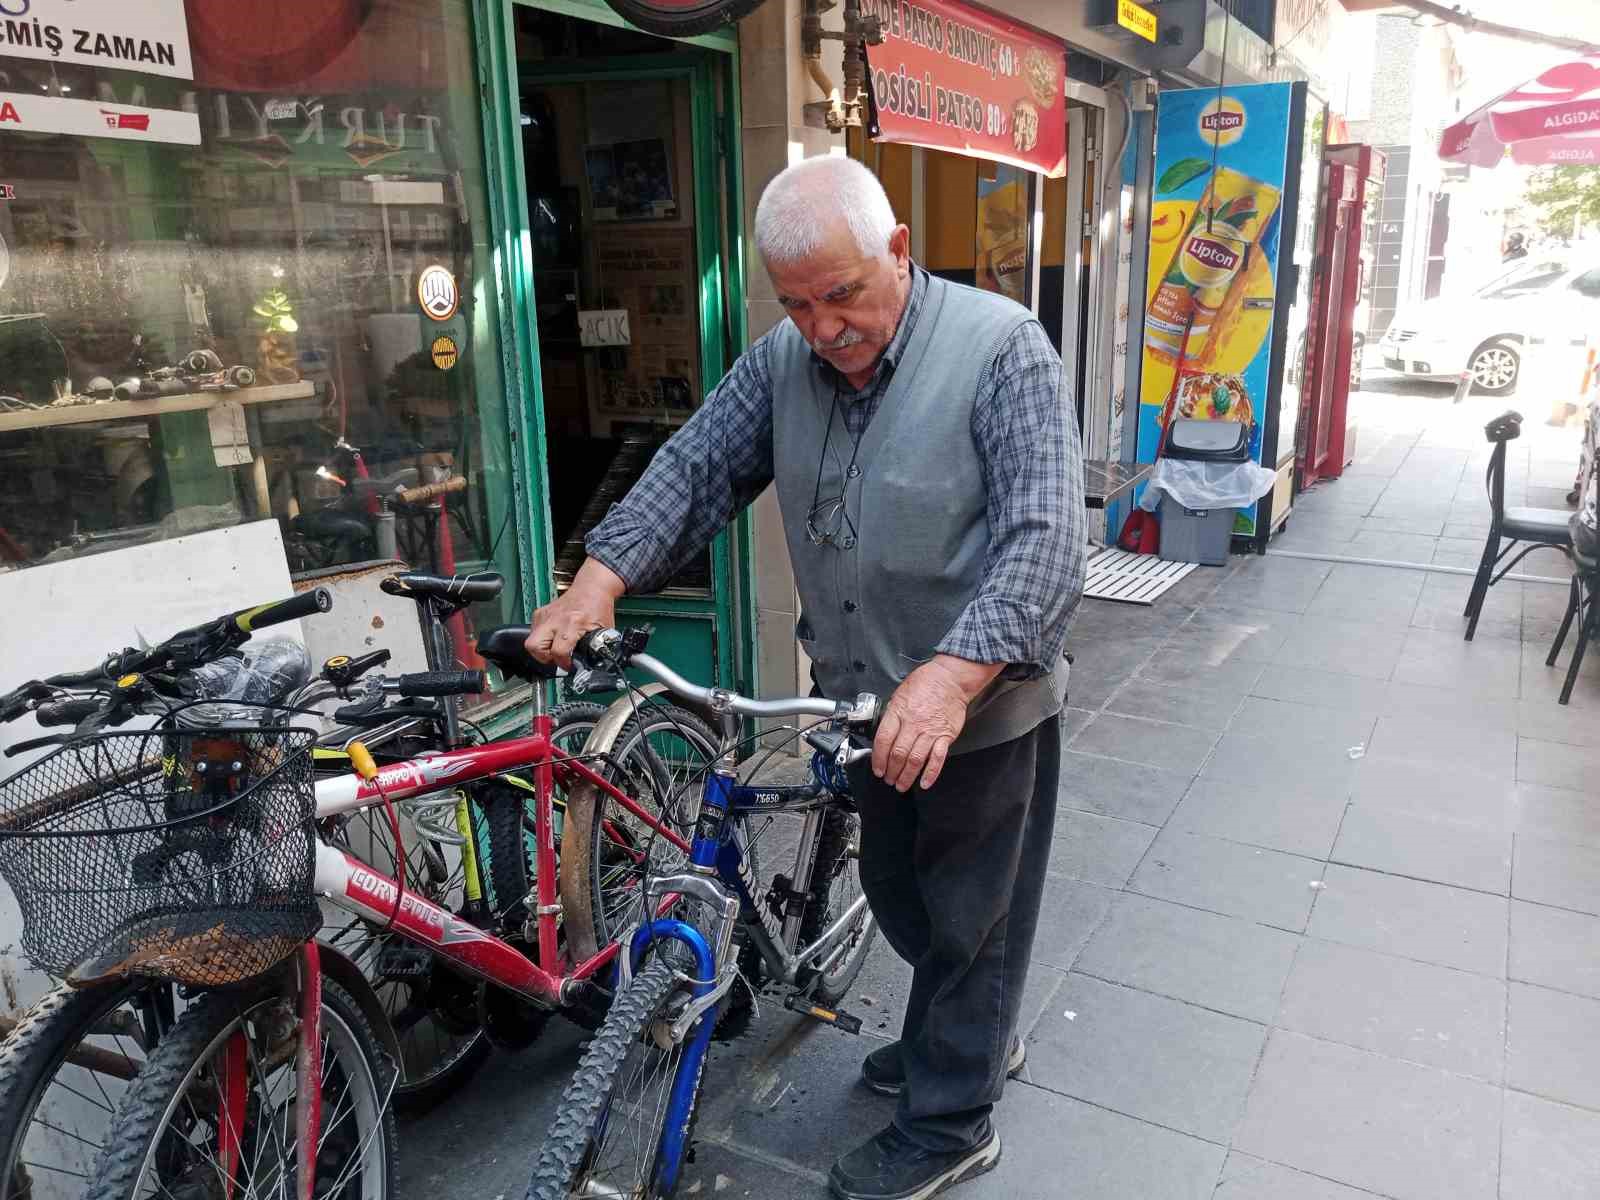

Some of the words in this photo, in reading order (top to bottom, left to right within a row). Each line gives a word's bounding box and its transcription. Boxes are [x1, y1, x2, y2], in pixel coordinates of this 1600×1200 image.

[0, 17, 63, 56] MİŞ
[72, 29, 176, 66] ZAMAN
[902, 3, 943, 54] PATSO
[946, 20, 998, 80] SANDVİÇ
[870, 64, 931, 121] OSİSLİ
[936, 86, 984, 134] PATSO
[987, 103, 1000, 136] 80
[1205, 115, 1239, 129] Lipton
[1190, 240, 1234, 268] Lipton
